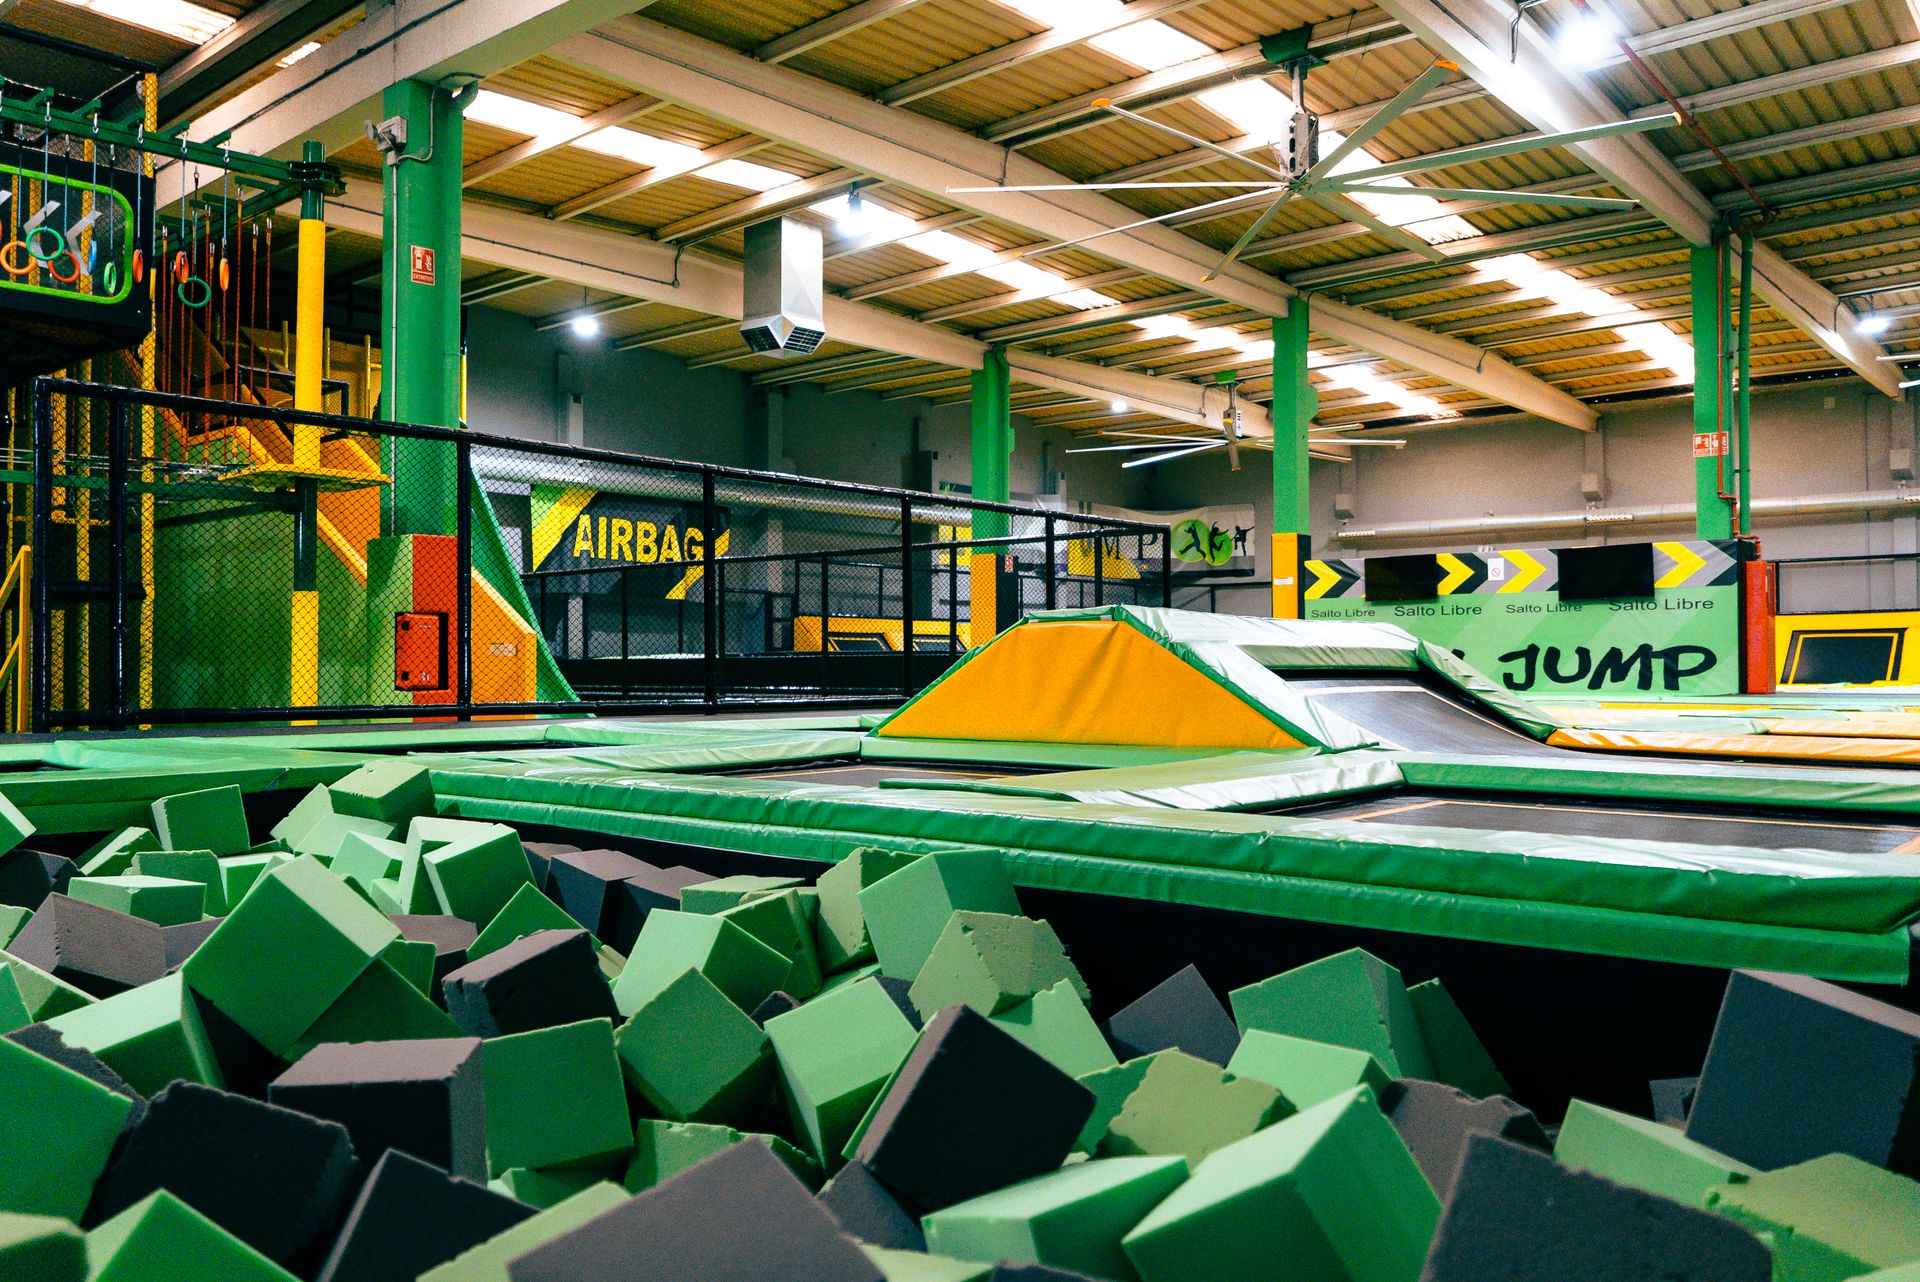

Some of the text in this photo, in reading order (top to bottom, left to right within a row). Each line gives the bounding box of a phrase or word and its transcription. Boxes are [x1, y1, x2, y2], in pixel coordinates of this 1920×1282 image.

[573, 515, 704, 563] AIRBAG
[1394, 604, 1483, 617] Salto Libre
[1506, 602, 1582, 613] Salto Libre
[1608, 598, 1715, 612] Salto Libre
[1311, 608, 1376, 618] Salto Libre
[1498, 643, 1717, 691] JUMP
